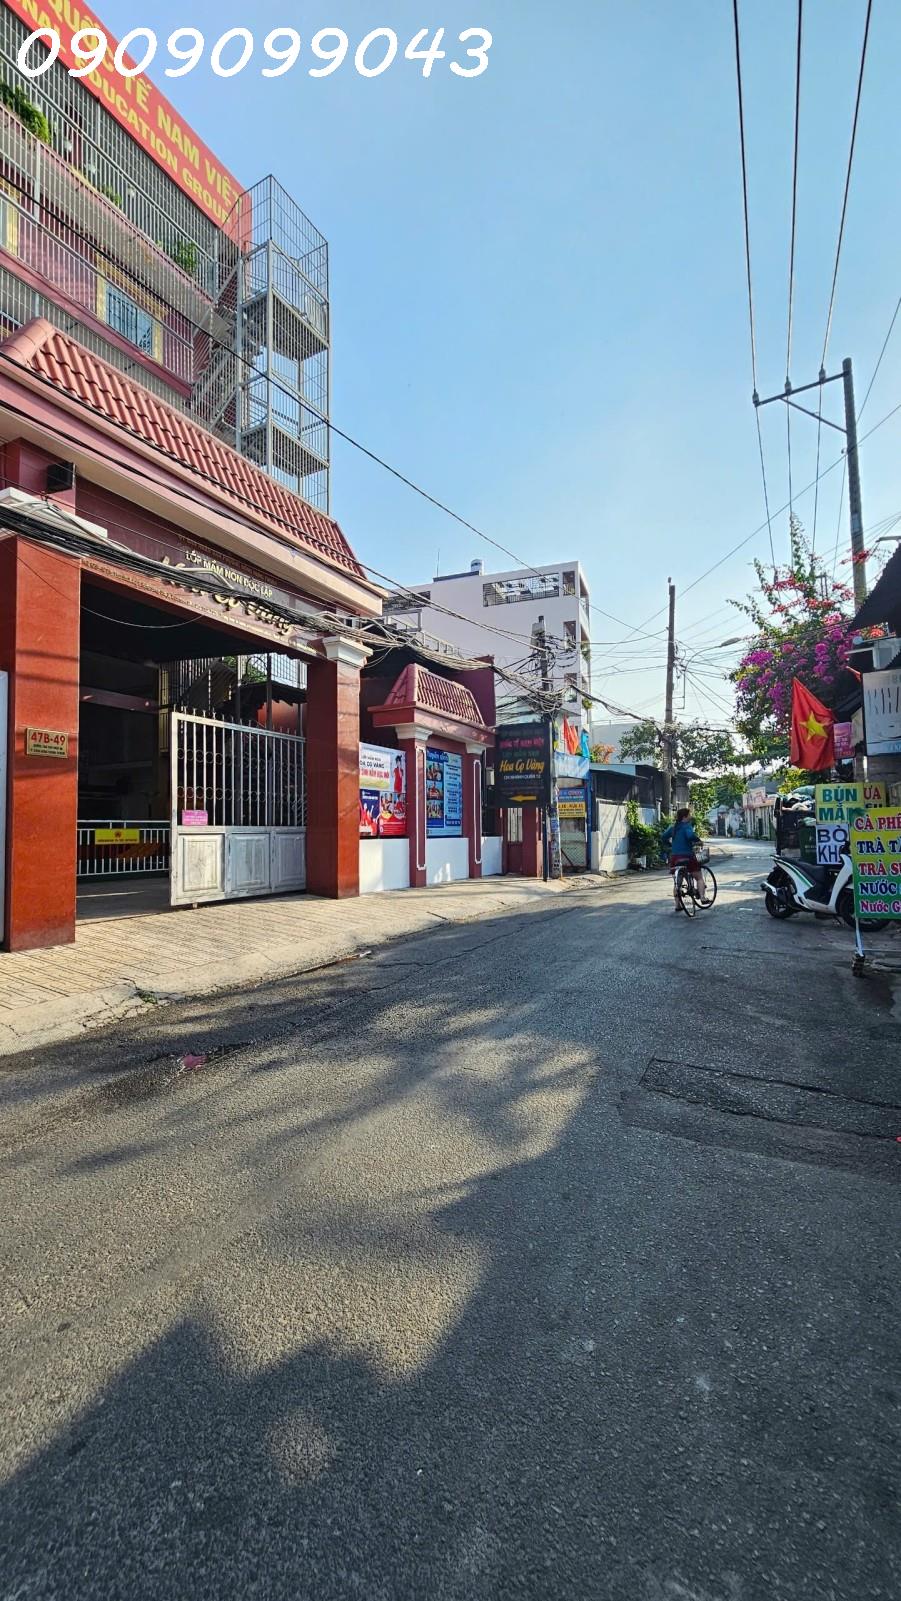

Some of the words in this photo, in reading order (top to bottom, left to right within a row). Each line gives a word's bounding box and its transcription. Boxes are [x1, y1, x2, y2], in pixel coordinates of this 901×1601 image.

[157, 105, 200, 171] NAM
[205, 157, 243, 215] VIỆT
[182, 167, 230, 225] GROUP
[185, 550, 202, 565] LỚP
[203, 559, 225, 576] MẦM
[225, 569, 243, 586] NON
[260, 584, 273, 599] LẬP
[31, 731, 66, 746] 47B-49
[499, 760, 514, 773] Hoa
[515, 759, 525, 773] Cọ
[526, 758, 545, 774] Vàng
[823, 786, 857, 802] BÚN
[855, 814, 874, 831] CÀ
[818, 825, 847, 843] BÒ
[857, 836, 885, 853] TRÀ
[859, 860, 886, 876] TRÀ
[860, 880, 897, 895] NƯỚC
[861, 899, 888, 912] Nước
